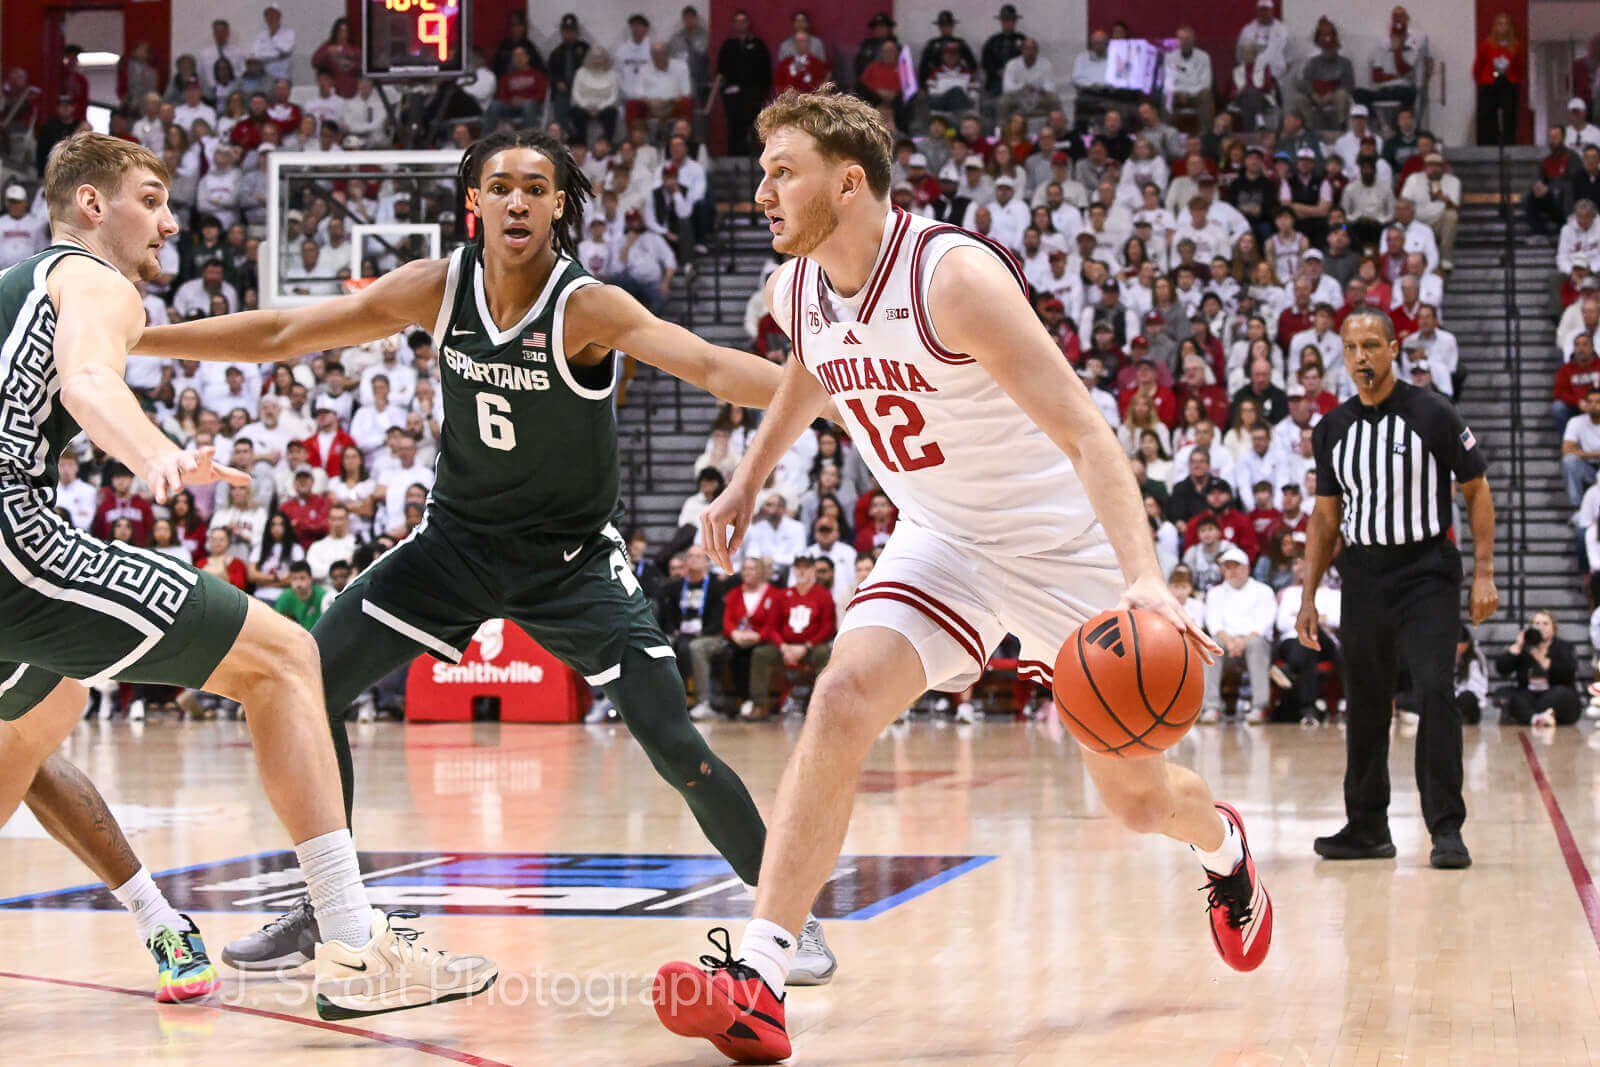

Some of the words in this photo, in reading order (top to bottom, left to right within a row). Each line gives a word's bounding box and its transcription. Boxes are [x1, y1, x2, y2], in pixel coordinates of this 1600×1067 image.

[418, 12, 447, 62] 9
[808, 311, 820, 327] 76
[443, 345, 551, 391] SPARTANS
[816, 357, 939, 396] INDIANA
[475, 391, 517, 452] 6
[844, 394, 945, 473] 12
[431, 660, 544, 684] Smithville
